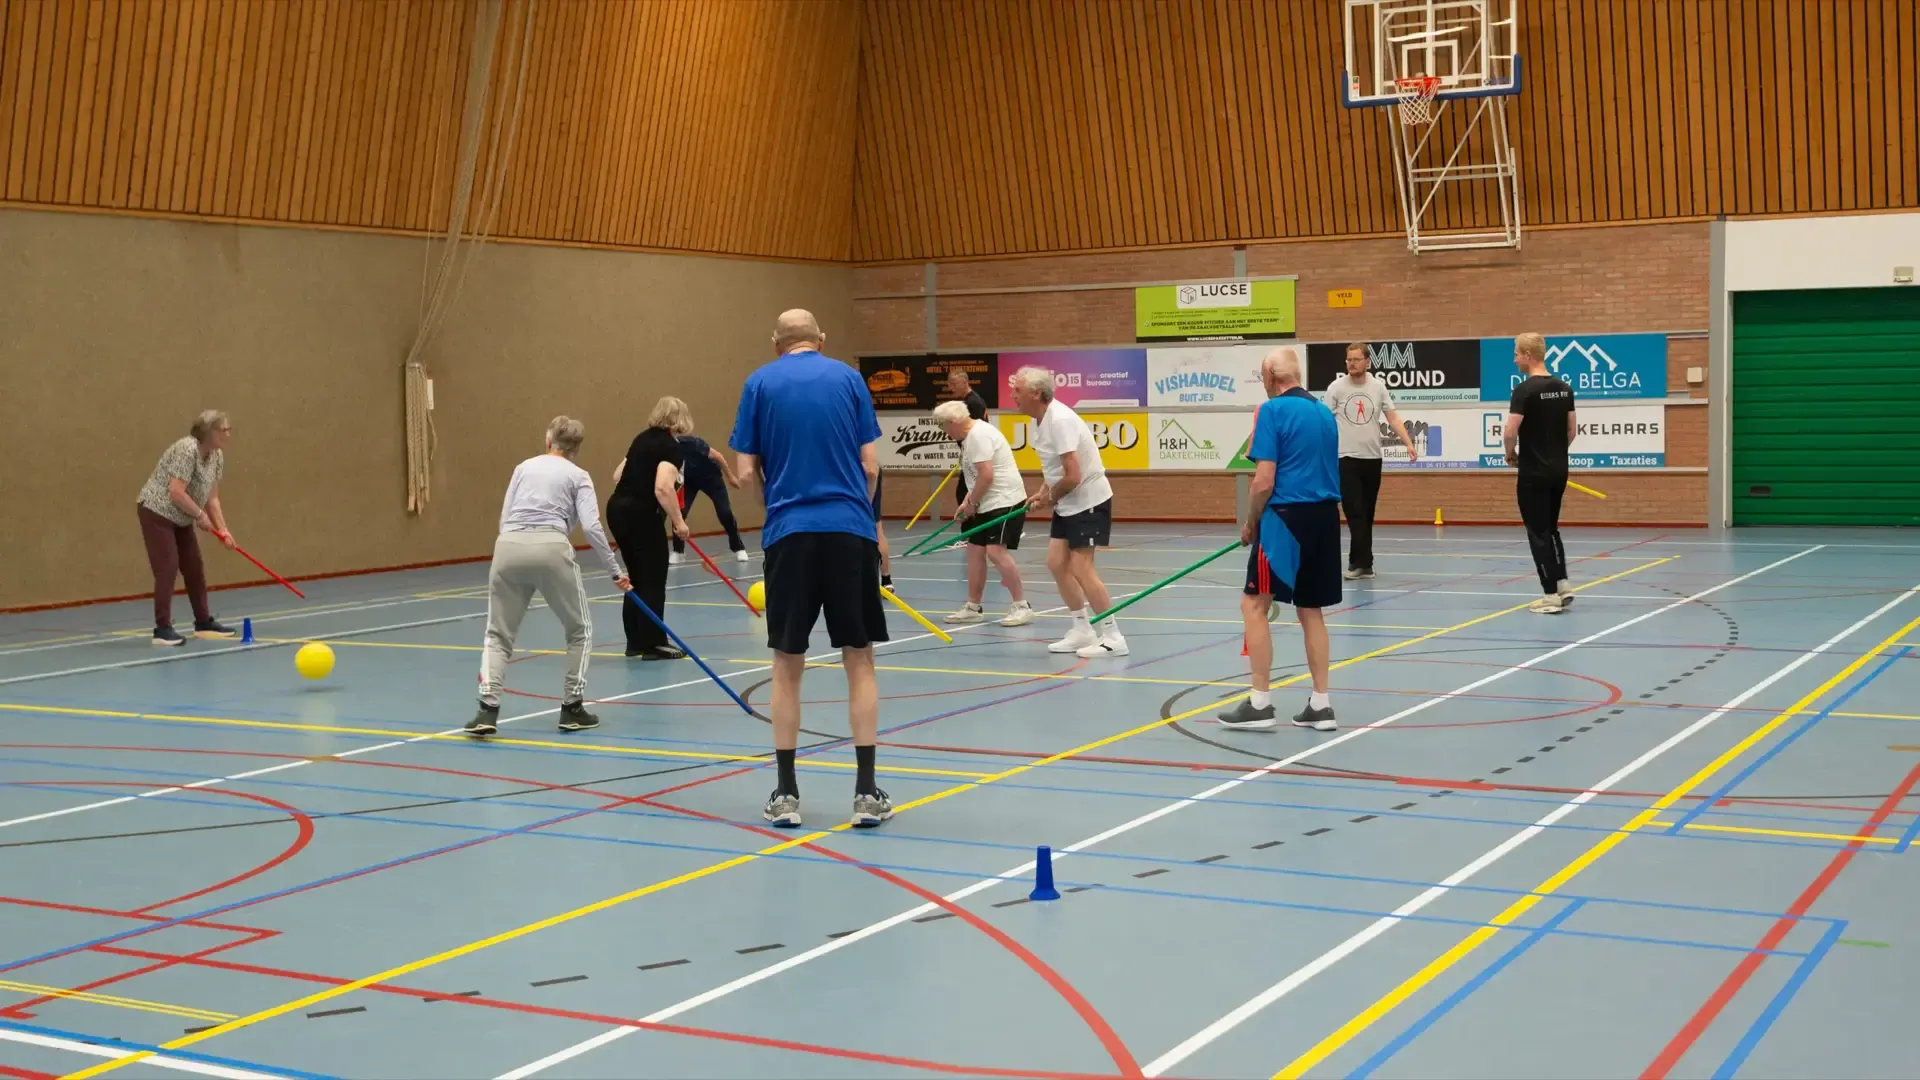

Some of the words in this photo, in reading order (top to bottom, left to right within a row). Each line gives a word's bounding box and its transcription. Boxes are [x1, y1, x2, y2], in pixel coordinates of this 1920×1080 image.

[1201, 284, 1248, 296] LUCSE
[1100, 371, 1129, 379] creatief
[1336, 370, 1445, 387] PSOUND
[1579, 372, 1642, 389] BELGA
[1086, 379, 1112, 387] bureau
[1155, 372, 1236, 394] VISHANDEL
[1401, 393, 1479, 403] www.mmprosound.com
[892, 425, 953, 443] Kram
[1577, 423, 1659, 436] KELAARS
[1159, 438, 1188, 450] H&H
[1159, 450, 1221, 461] DAKTECHNIEK
[1383, 449, 1409, 458] Bedum
[1484, 456, 1508, 466] Verk
[1568, 455, 1594, 468] koop
[1610, 455, 1657, 465] Taxaties
